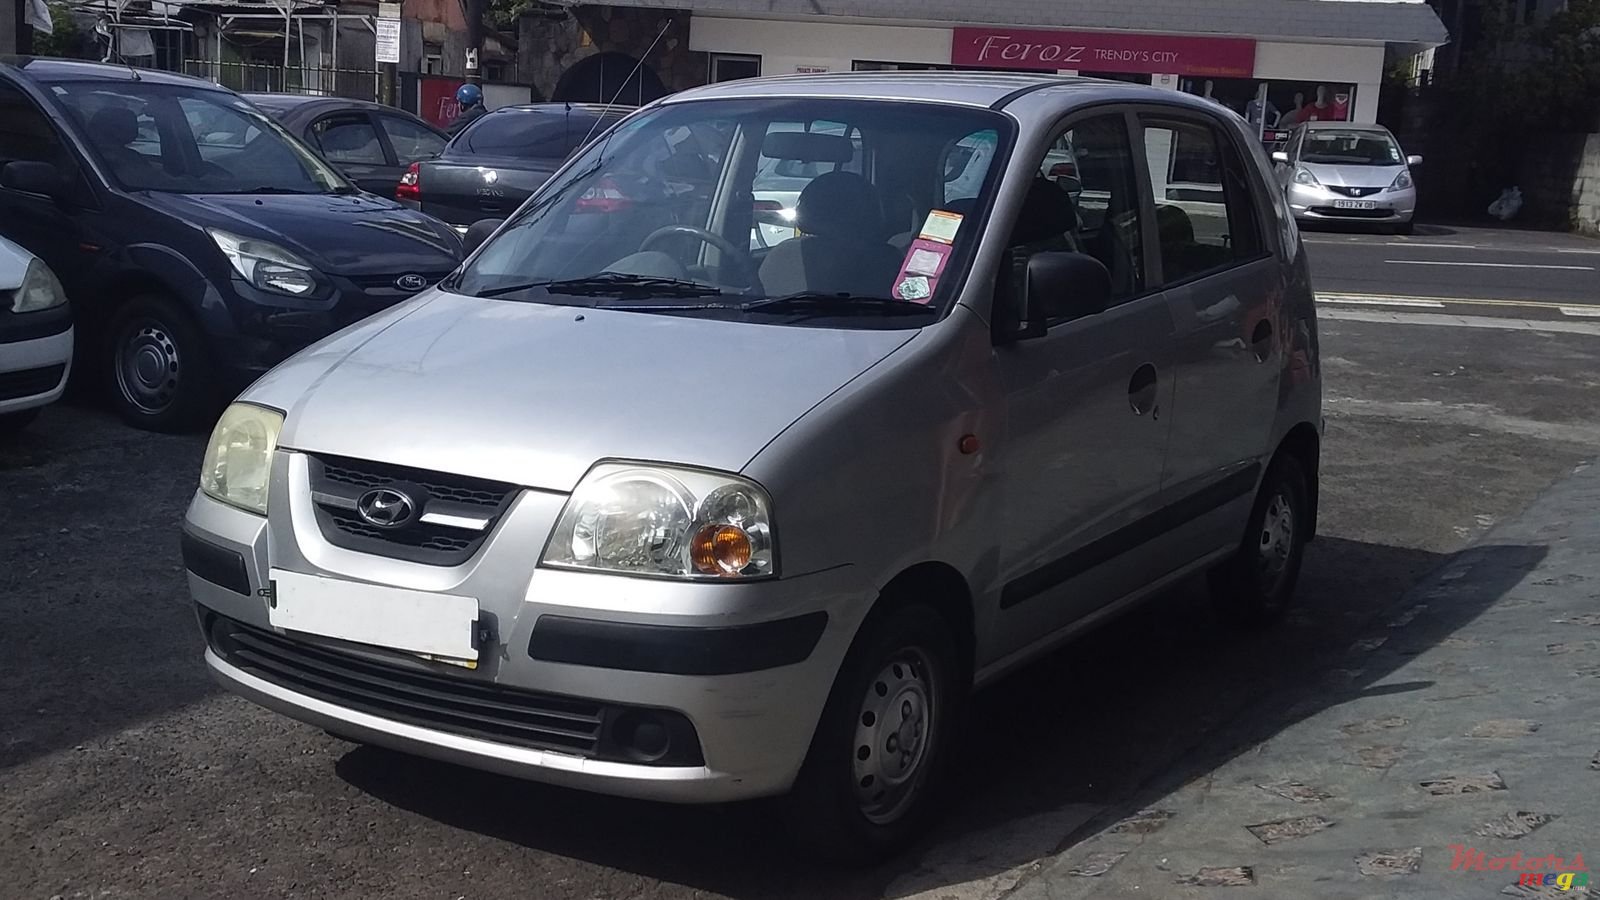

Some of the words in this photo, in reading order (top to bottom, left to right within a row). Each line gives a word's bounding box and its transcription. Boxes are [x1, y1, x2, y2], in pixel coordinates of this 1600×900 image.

[973, 35, 1087, 63] Feroz
[1094, 48, 1149, 62] TRENDY'S
[1151, 51, 1179, 63] CITY
